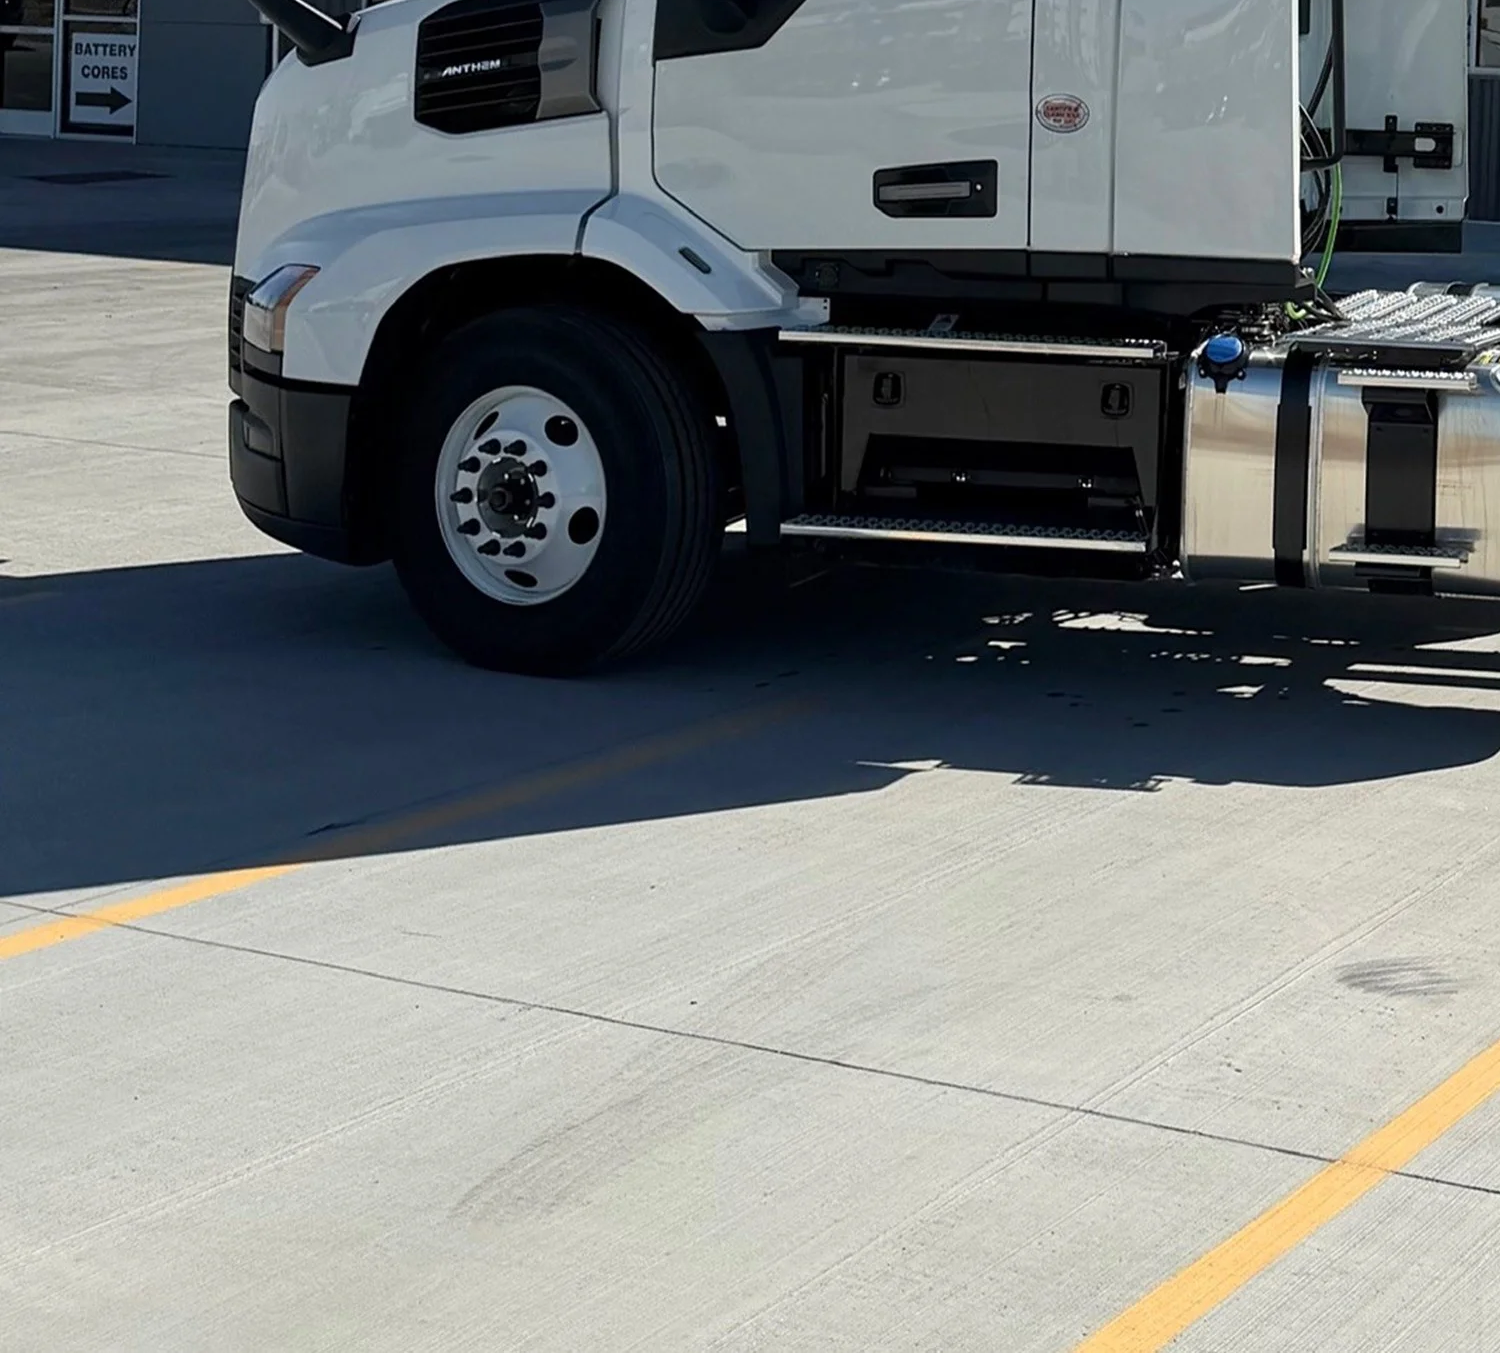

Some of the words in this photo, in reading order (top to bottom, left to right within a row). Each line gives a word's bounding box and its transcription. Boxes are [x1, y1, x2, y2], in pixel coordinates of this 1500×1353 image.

[75, 42, 137, 57] BATTERY
[81, 64, 128, 80] CORES
[441, 59, 501, 77] ANTHEM
